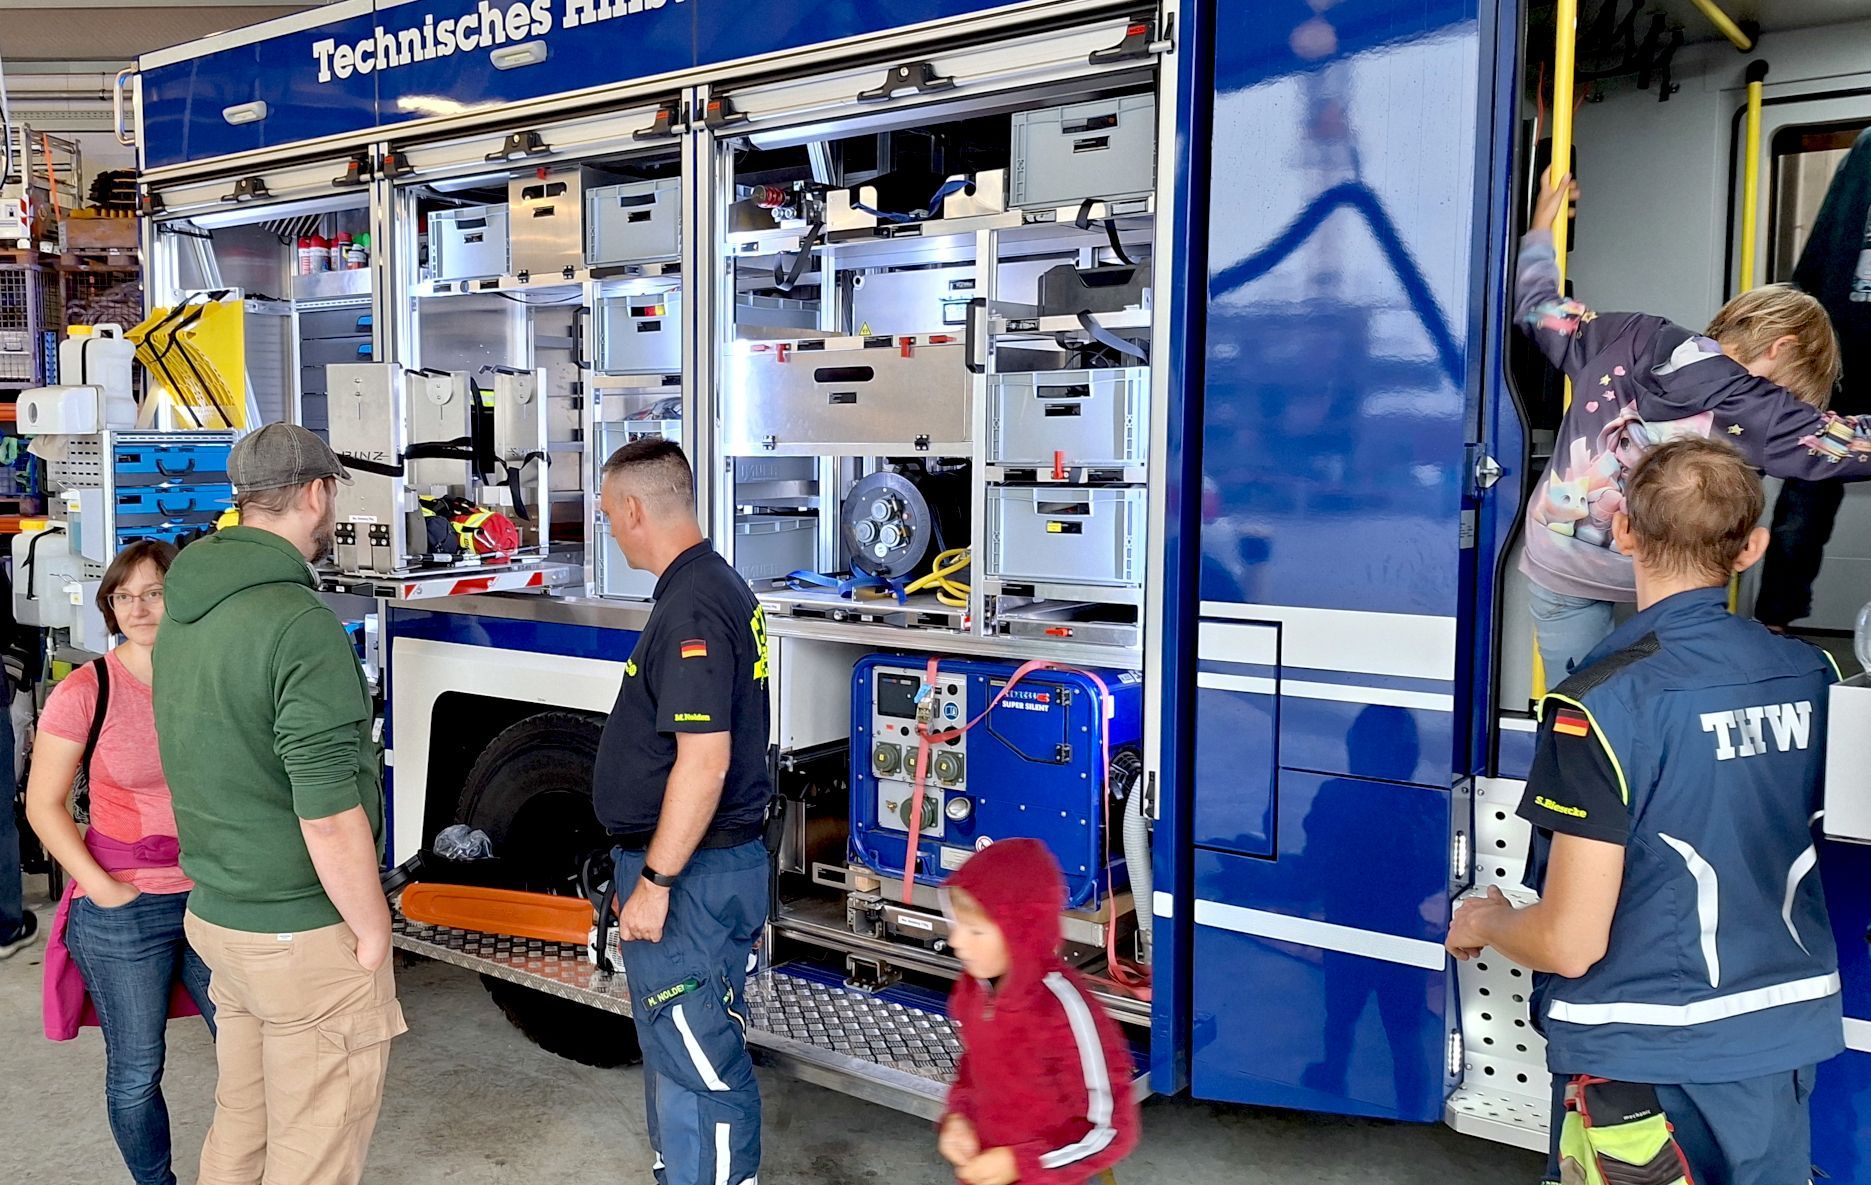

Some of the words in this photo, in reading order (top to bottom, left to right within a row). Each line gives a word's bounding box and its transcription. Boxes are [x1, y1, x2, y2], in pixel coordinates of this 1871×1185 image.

[312, 0, 552, 83] Technisches
[1002, 700, 1024, 710] SUPER
[1025, 702, 1050, 712] SILENT
[1699, 701, 1812, 761] THW
